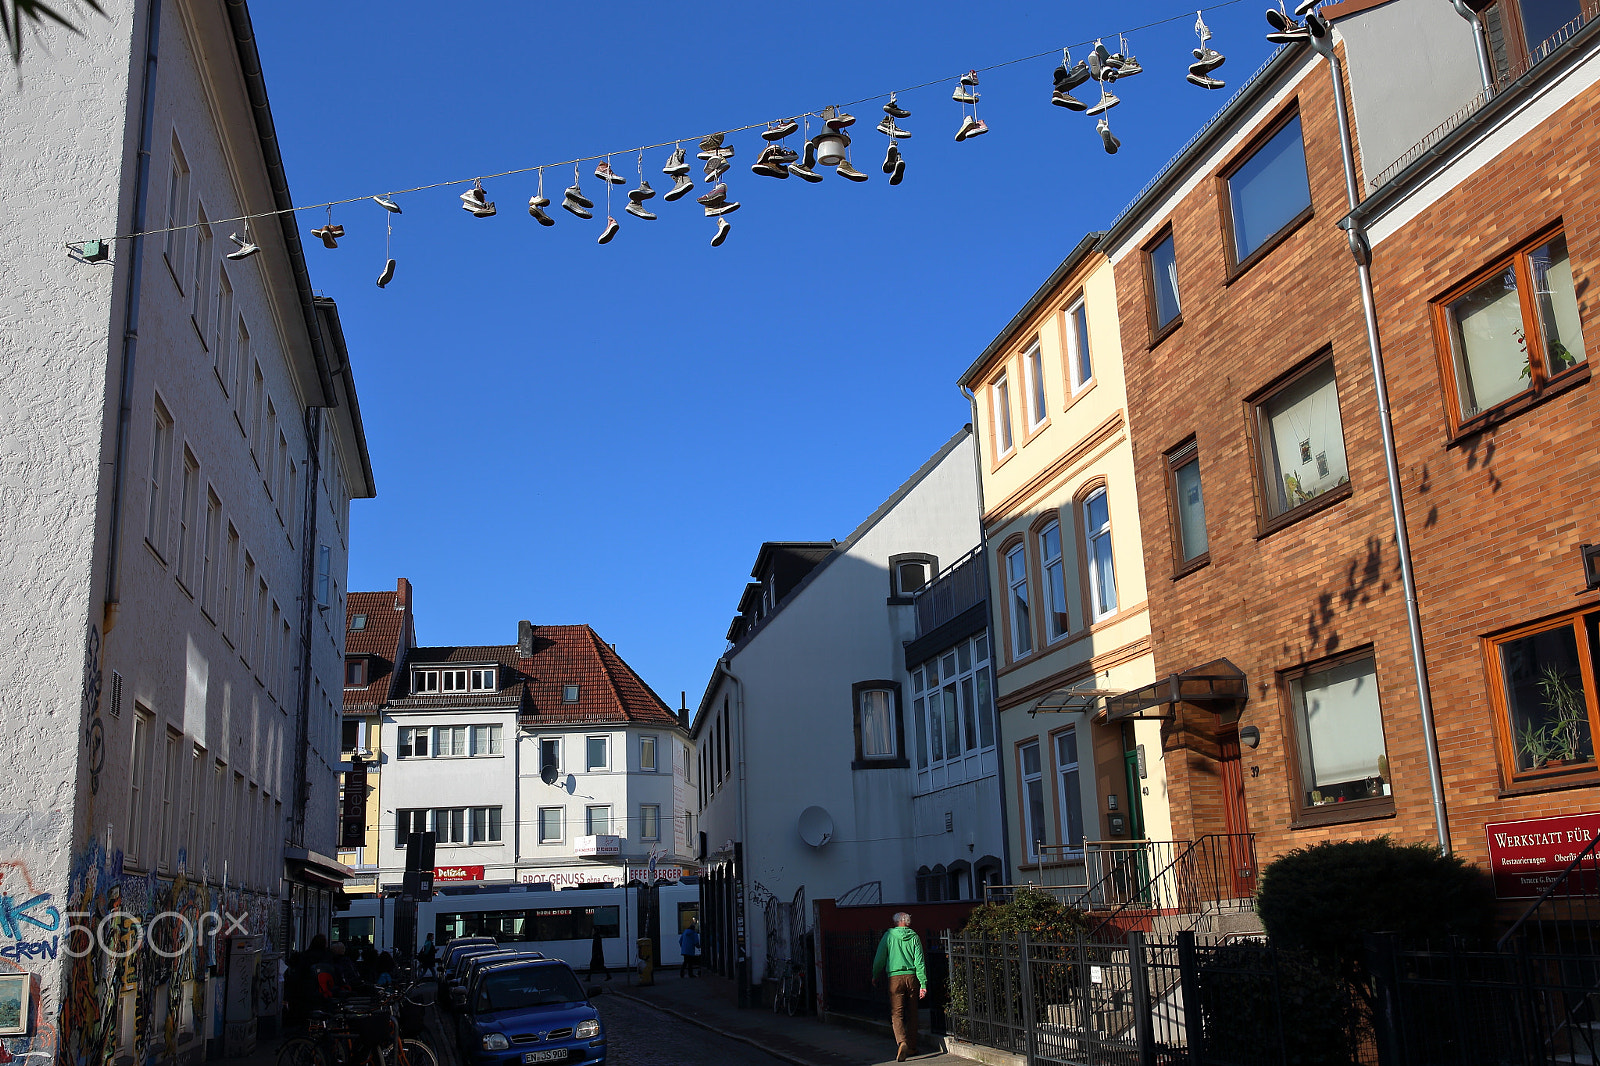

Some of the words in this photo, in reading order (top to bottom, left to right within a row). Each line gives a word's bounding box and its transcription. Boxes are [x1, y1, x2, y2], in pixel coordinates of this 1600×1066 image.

[1250, 766, 1260, 778] 39
[345, 769, 364, 817] bellini
[1566, 827, 1592, 843] FÜR
[1501, 856, 1547, 866] Restaurierungen
[523, 873, 585, 885] BROT-GENUSS
[630, 868, 682, 879] EFFEBERGER
